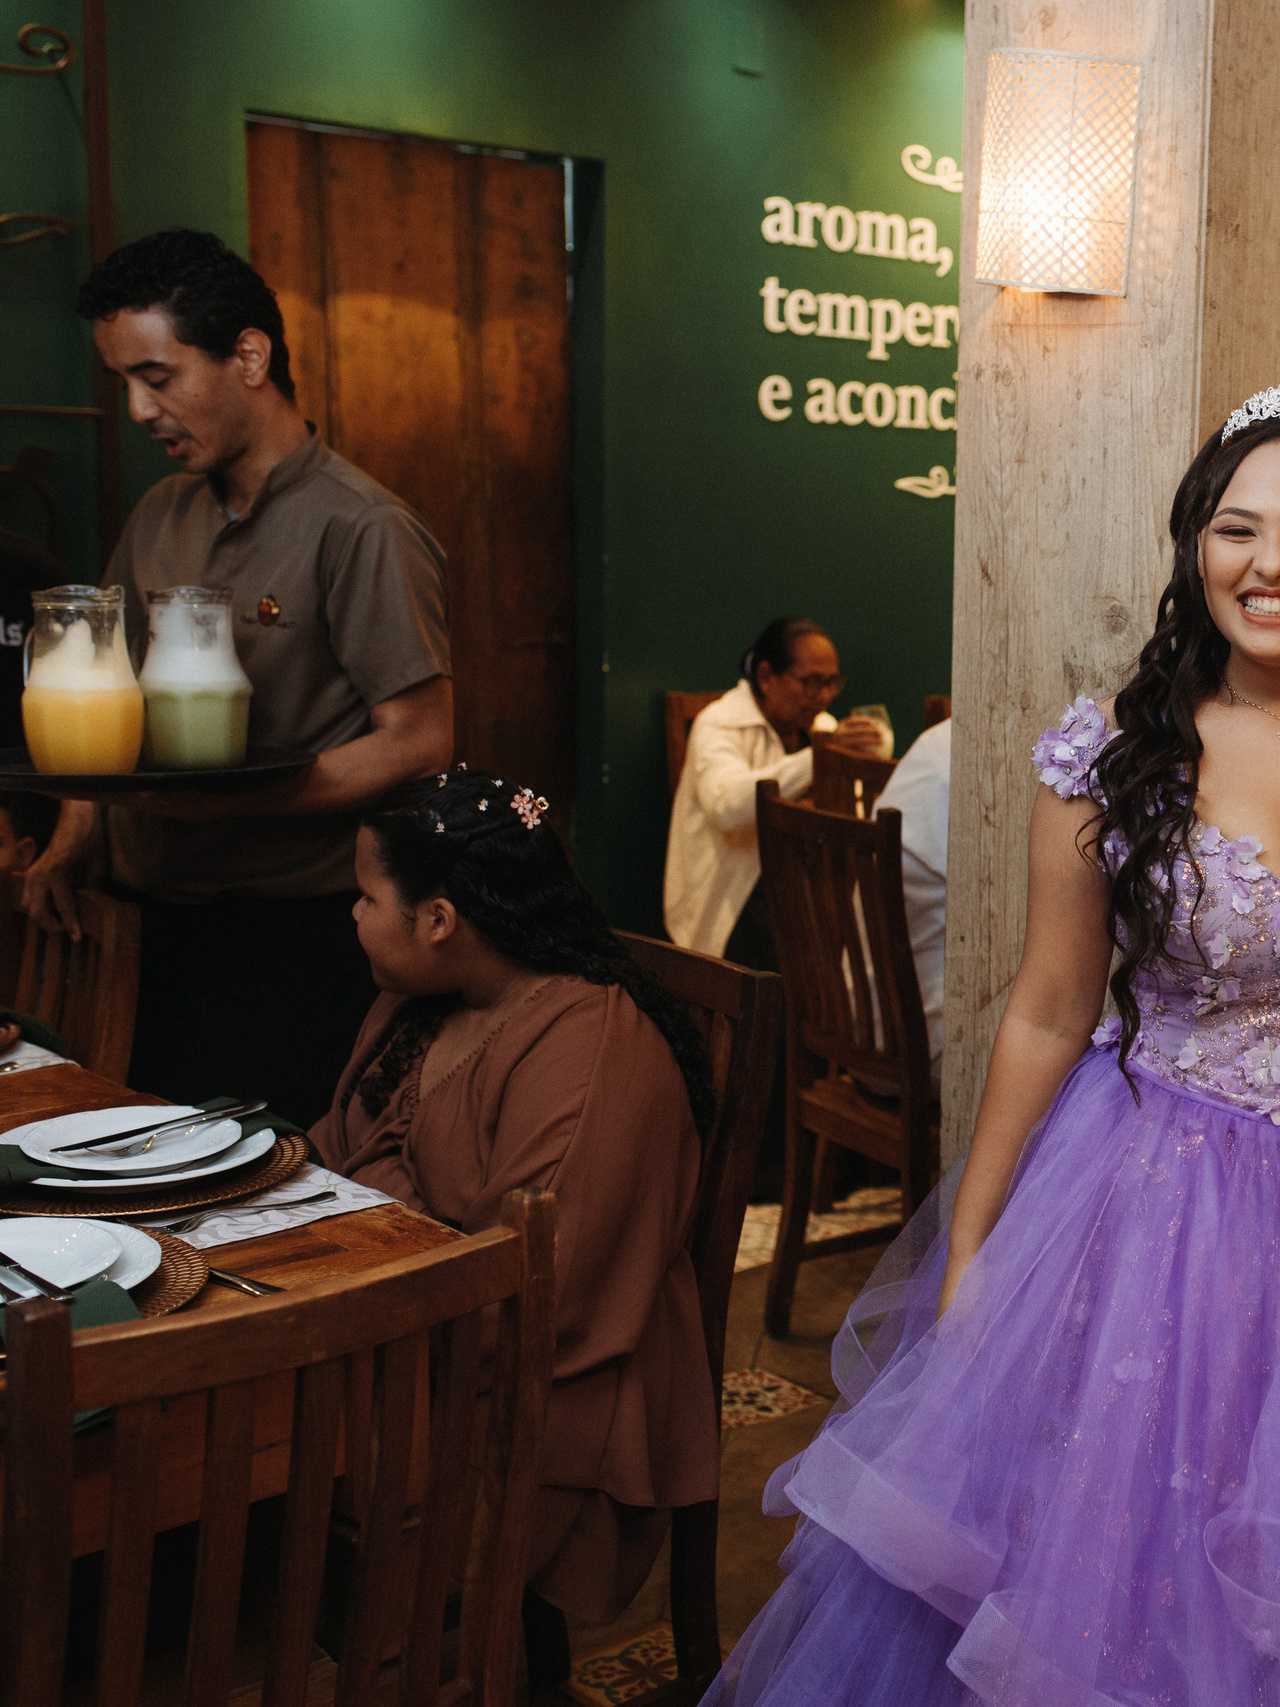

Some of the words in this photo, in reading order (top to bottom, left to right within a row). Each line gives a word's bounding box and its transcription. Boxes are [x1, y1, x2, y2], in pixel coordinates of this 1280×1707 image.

[761, 196, 954, 277] aroma,
[759, 276, 959, 361] temper
[757, 374, 793, 421] e
[804, 374, 957, 431] aconc
